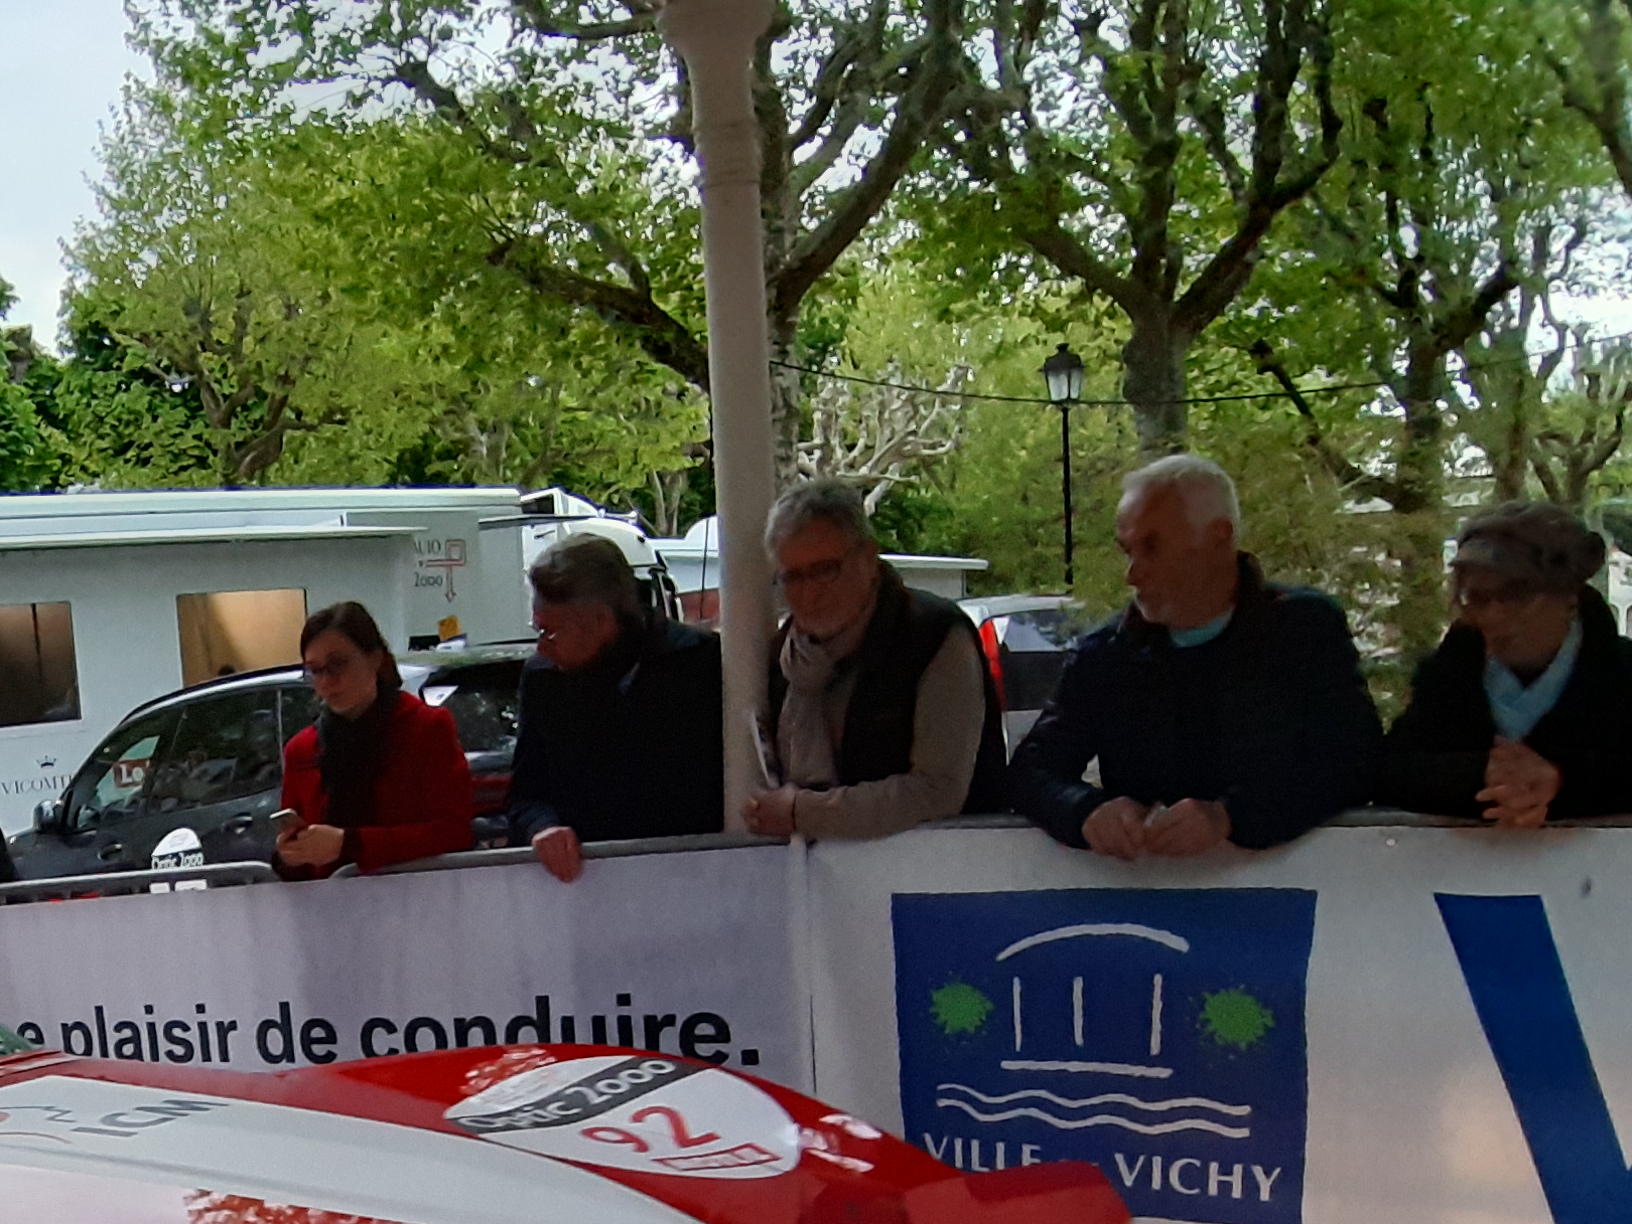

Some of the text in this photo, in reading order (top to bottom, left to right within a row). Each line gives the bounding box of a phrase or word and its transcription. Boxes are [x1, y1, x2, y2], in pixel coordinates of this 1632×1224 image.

[60, 1004, 238, 1064] plaisir
[255, 1001, 337, 1064] de
[359, 994, 760, 1066] conduire.
[70, 1098, 230, 1138] ICM
[457, 1100, 582, 1128] Optic
[564, 1058, 676, 1105] 2000
[579, 1105, 722, 1152] 92
[1114, 1152, 1282, 1202] VICHY
